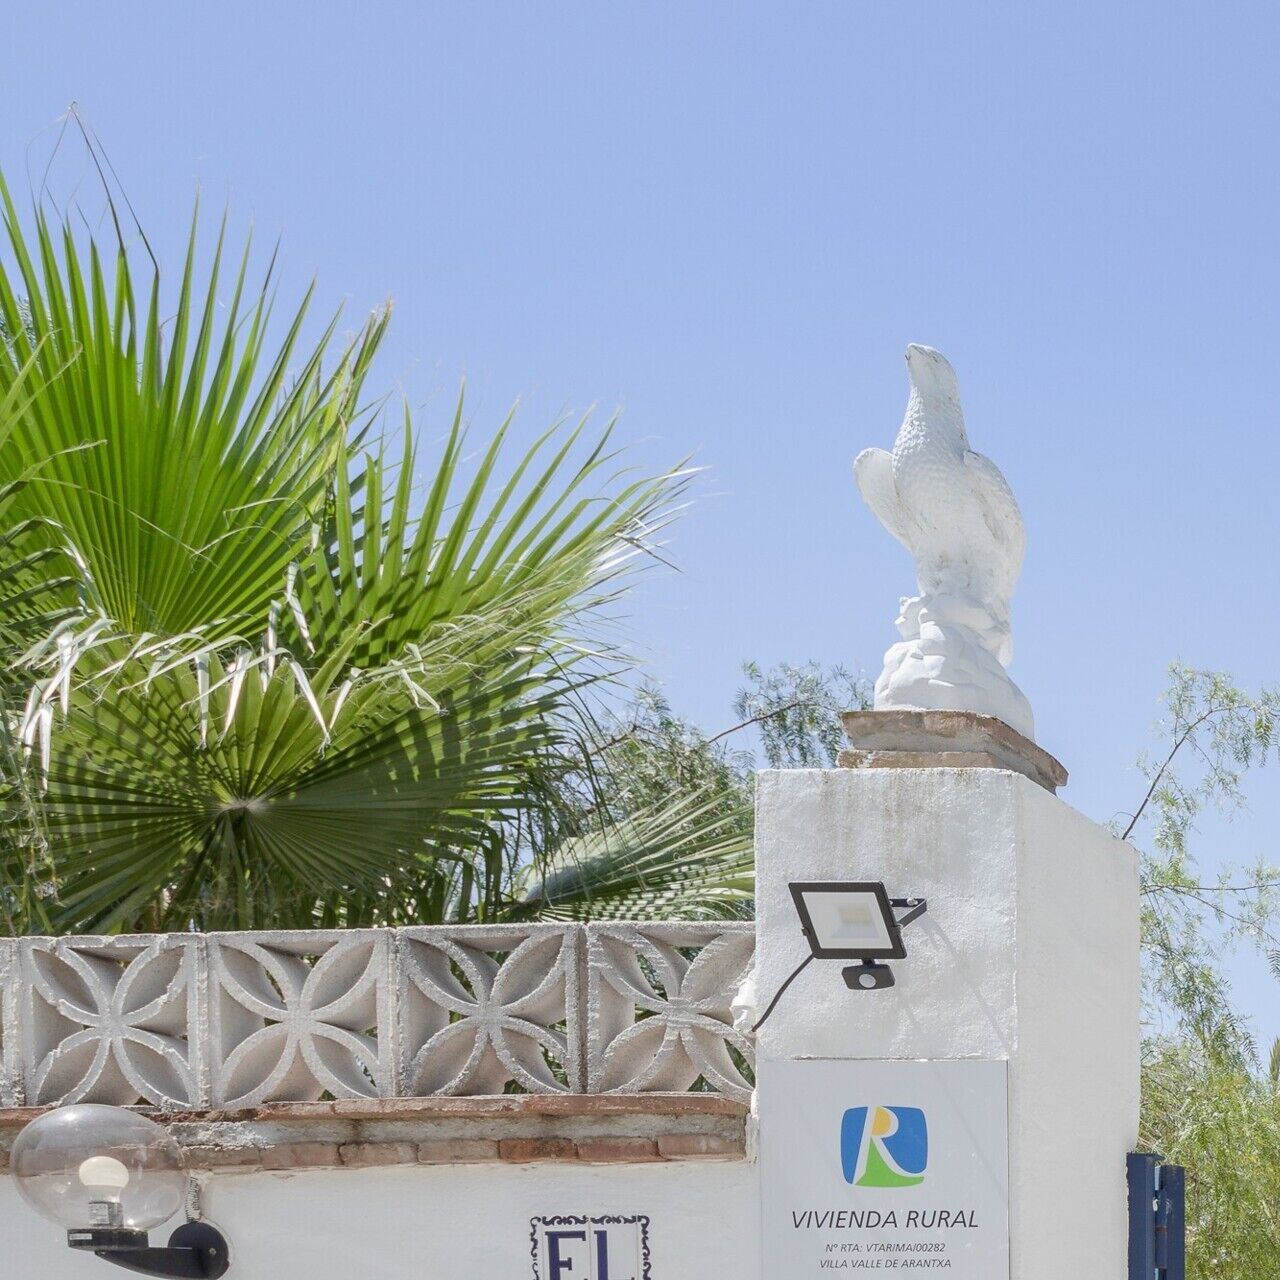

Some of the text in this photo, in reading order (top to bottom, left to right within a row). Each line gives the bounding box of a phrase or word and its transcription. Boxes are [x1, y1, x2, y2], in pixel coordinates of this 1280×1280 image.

[792, 1211, 979, 1228] VIVIENDA RURAL
[841, 1244, 862, 1252] RTA:
[820, 1259, 951, 1268] VILLA VALLE DE ARANTXA
